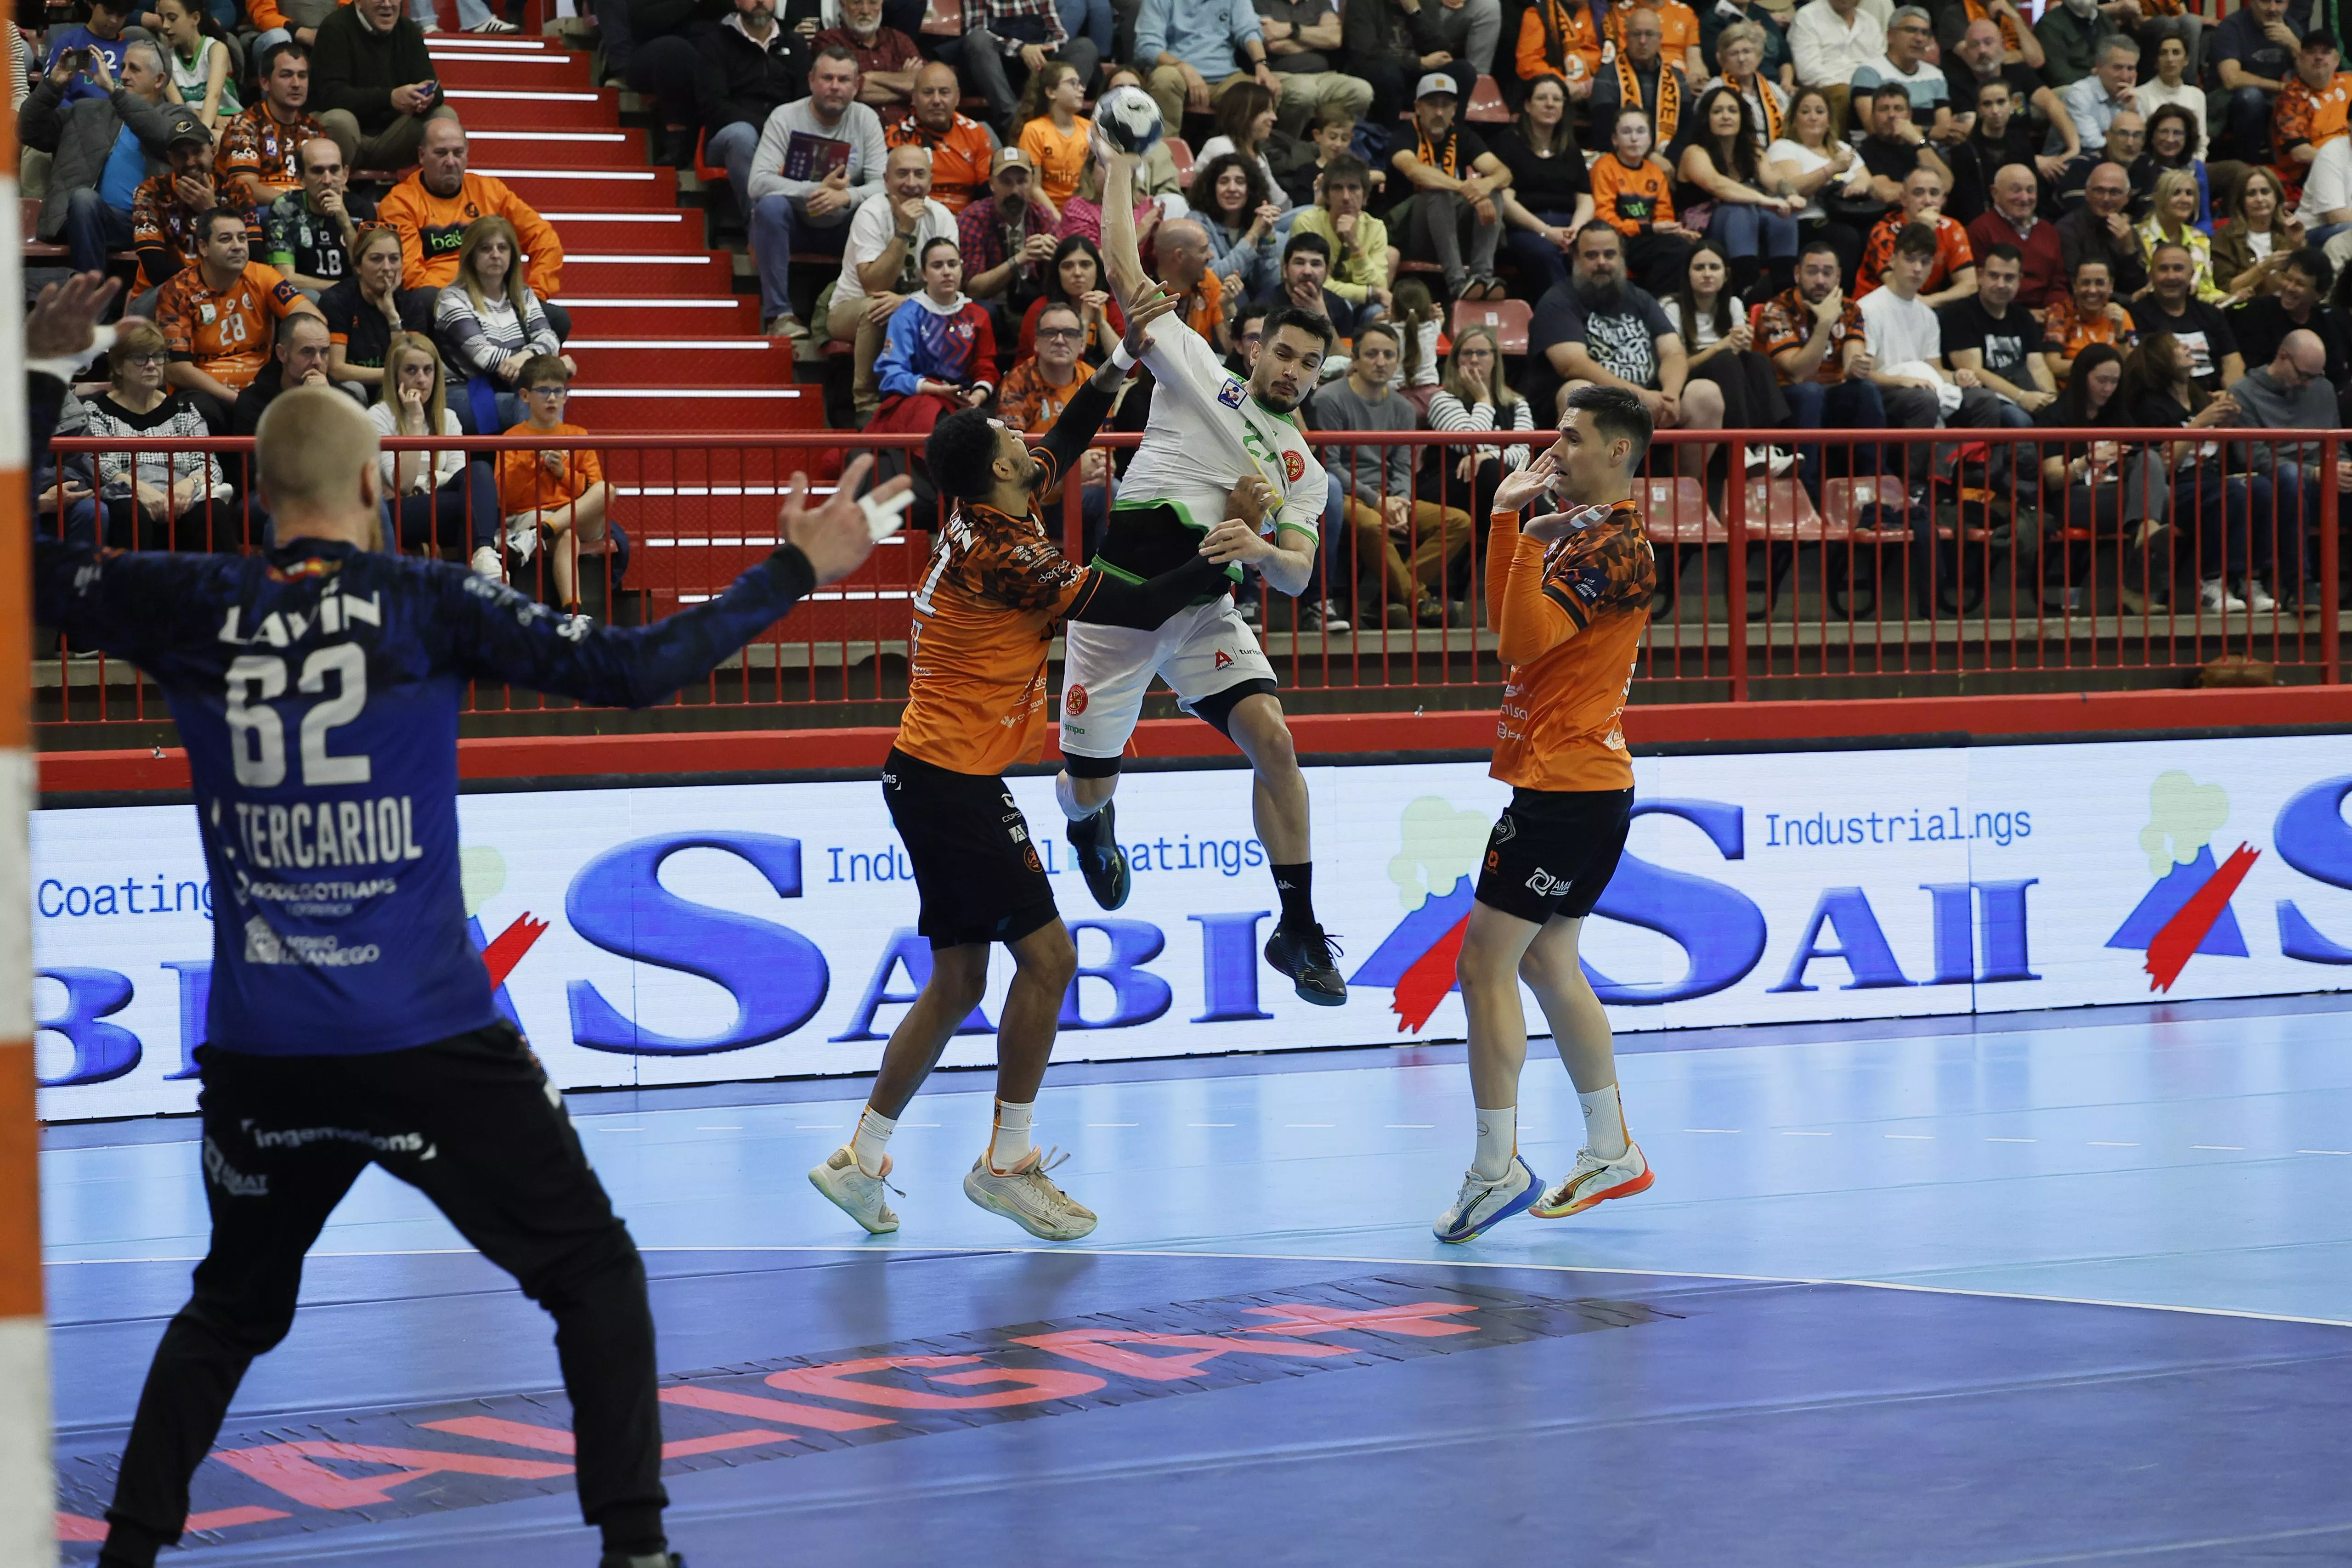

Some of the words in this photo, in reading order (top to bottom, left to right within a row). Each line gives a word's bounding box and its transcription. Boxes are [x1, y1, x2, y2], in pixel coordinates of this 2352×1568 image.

[316, 248, 343, 275] 18
[220, 312, 246, 346] 28
[218, 577, 382, 649] LAVÍN
[225, 641, 371, 788] 62
[1063, 720, 1086, 735] empa
[235, 795, 423, 869] TERCARIOL
[38, 874, 212, 918] Coating
[565, 829, 1275, 1057] SABI
